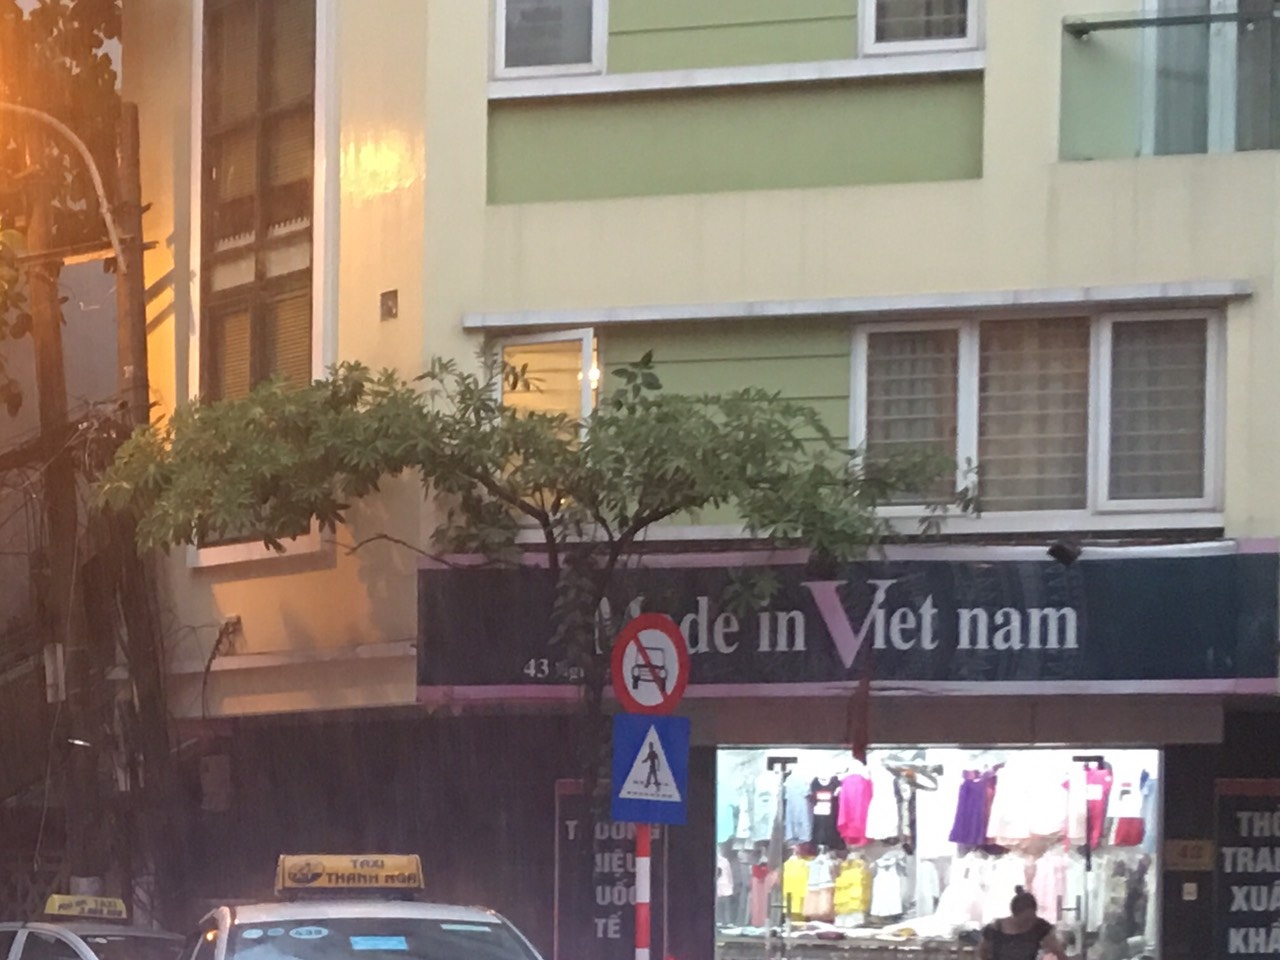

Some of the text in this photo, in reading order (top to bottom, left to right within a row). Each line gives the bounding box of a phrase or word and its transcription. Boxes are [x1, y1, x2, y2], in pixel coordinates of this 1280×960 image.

[757, 609, 807, 651] in
[802, 578, 939, 669] Viet
[956, 606, 1078, 650] nam
[523, 658, 550, 679] 43
[350, 859, 385, 869] TAXI
[326, 872, 417, 884] THANH NGA
[594, 912, 621, 938] TẾ
